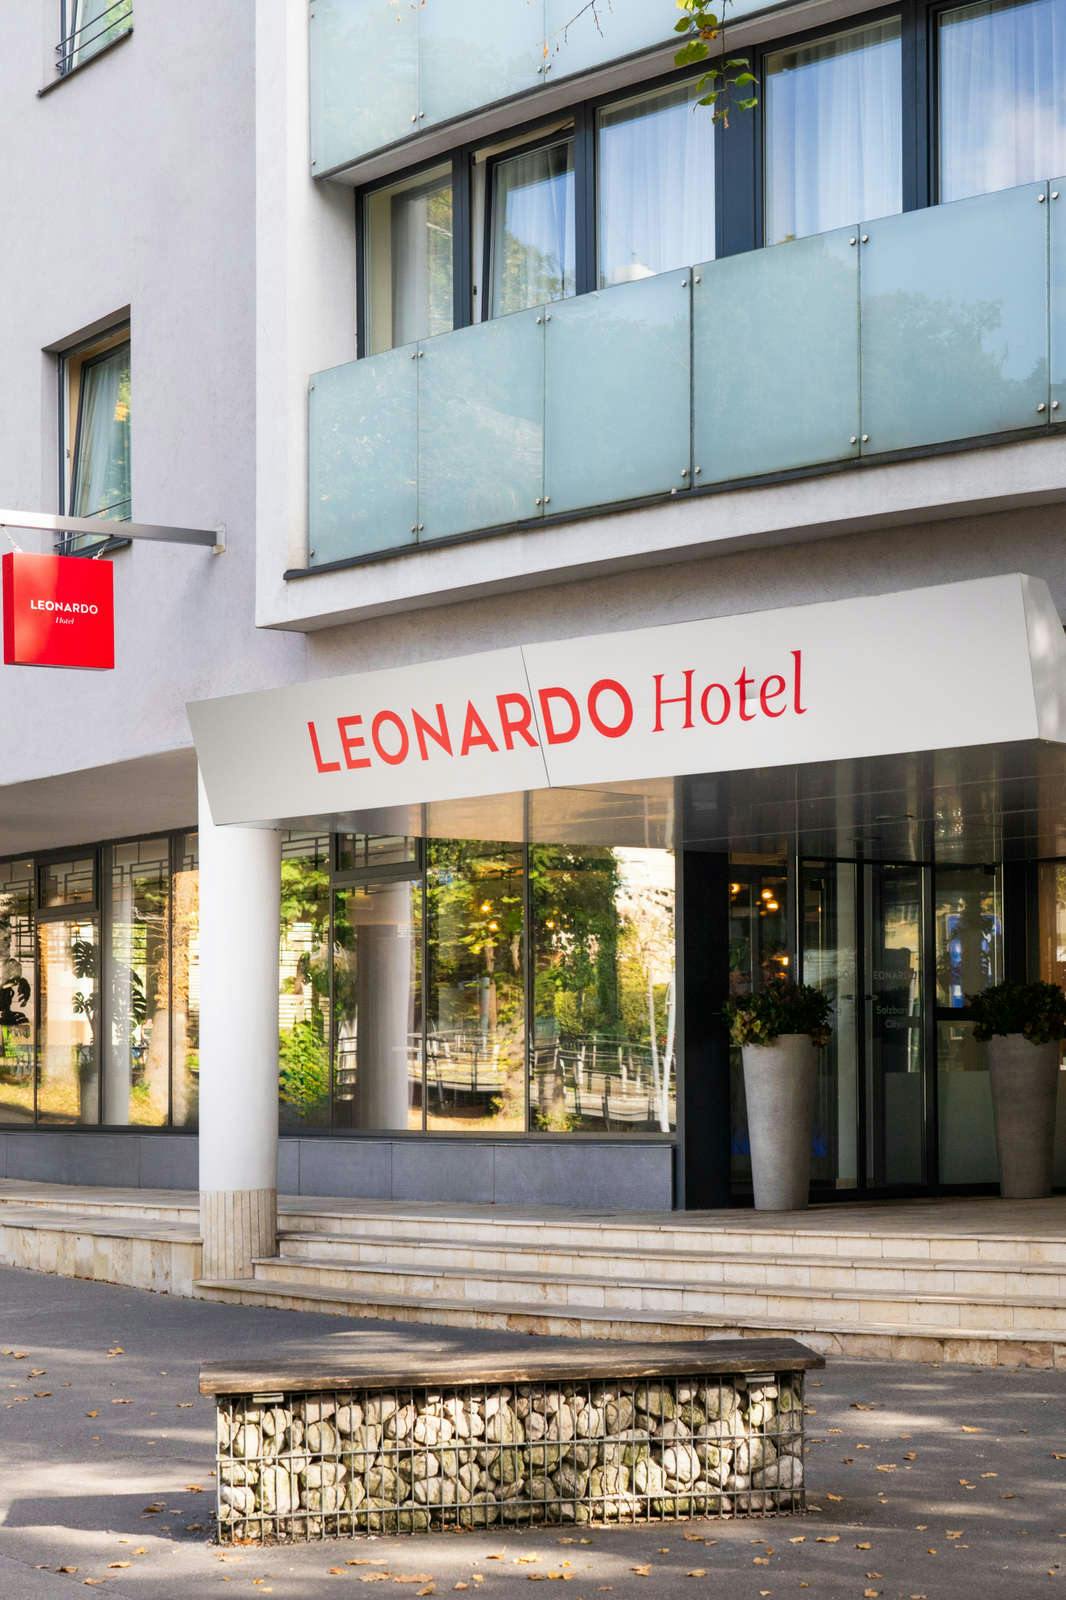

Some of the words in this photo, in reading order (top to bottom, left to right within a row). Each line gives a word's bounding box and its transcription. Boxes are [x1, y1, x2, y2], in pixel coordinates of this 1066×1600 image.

[30, 599, 98, 615] LEONARDO
[55, 616, 75, 625] Hotel
[307, 678, 634, 774] LEONARDO
[651, 649, 807, 733] Hotel
